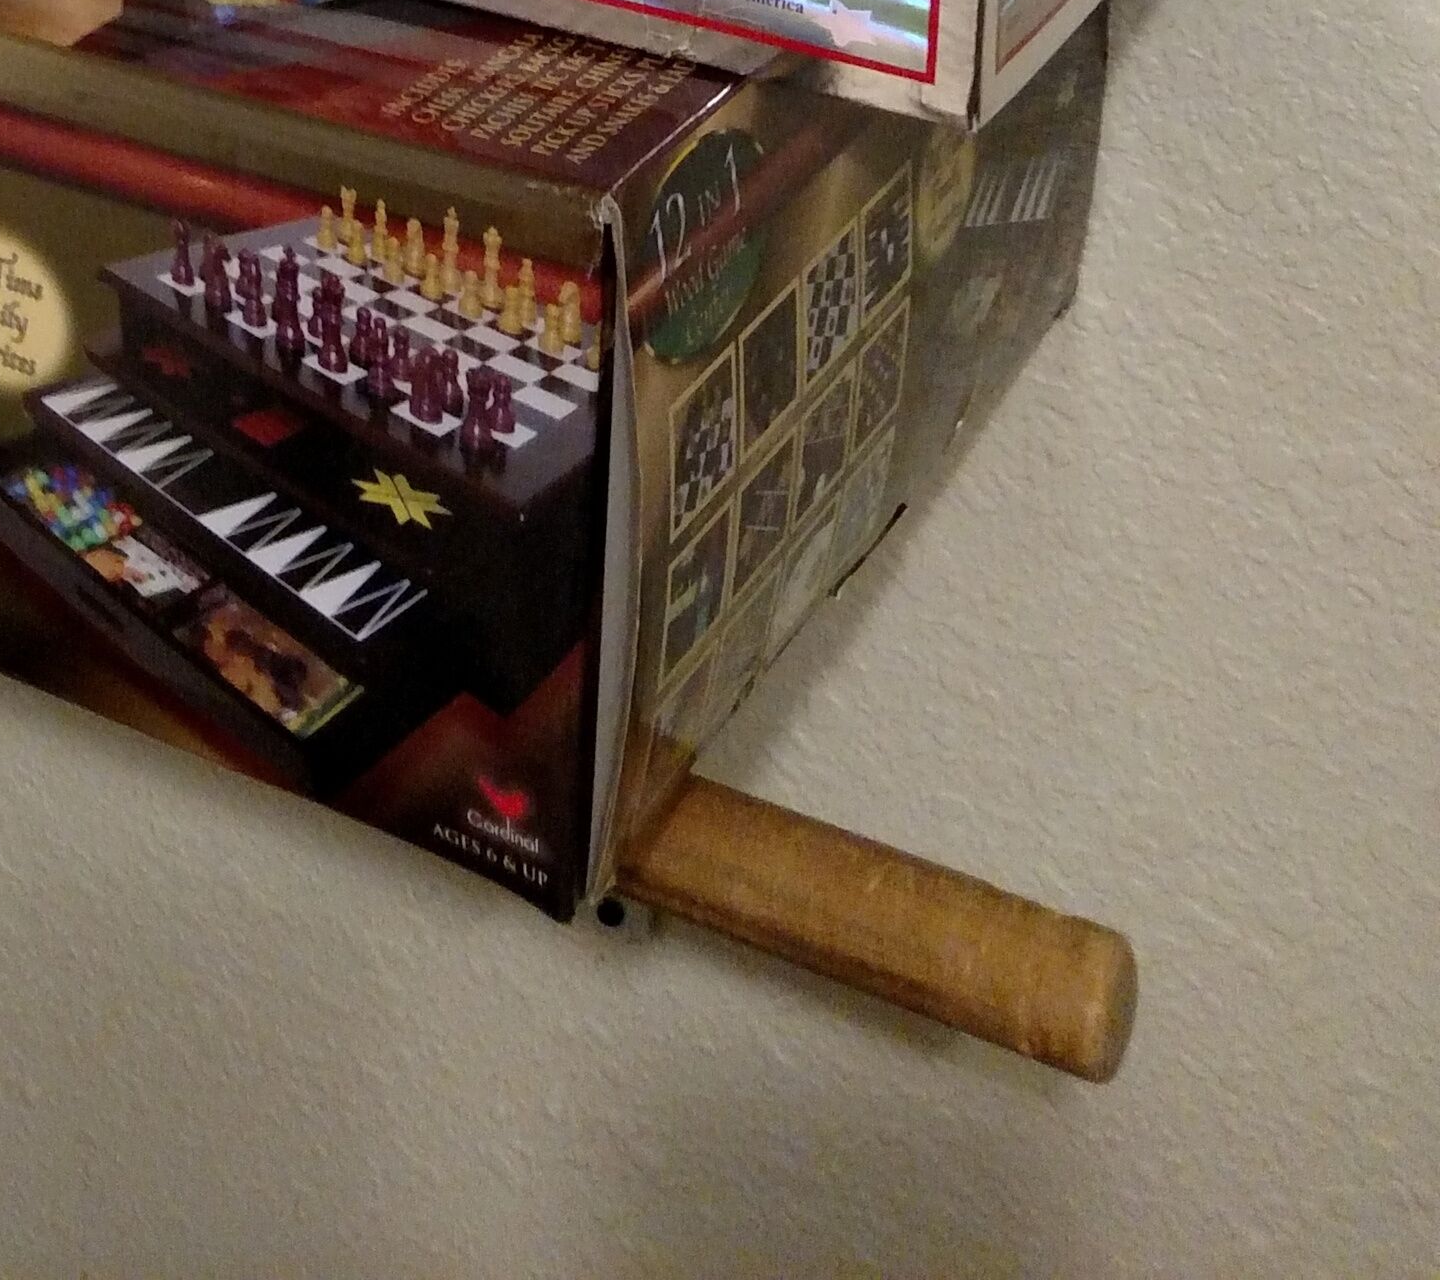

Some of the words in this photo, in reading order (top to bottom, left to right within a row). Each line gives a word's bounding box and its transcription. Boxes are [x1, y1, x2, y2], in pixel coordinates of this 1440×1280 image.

[527, 123, 580, 156] PICK
[560, 132, 610, 164] AND
[594, 90, 660, 135] SNAKES
[649, 192, 692, 284] 12
[724, 143, 741, 216] 1
[433, 822, 481, 855] AGES
[522, 862, 548, 887] UP
[466, 807, 539, 855] Cardinal
